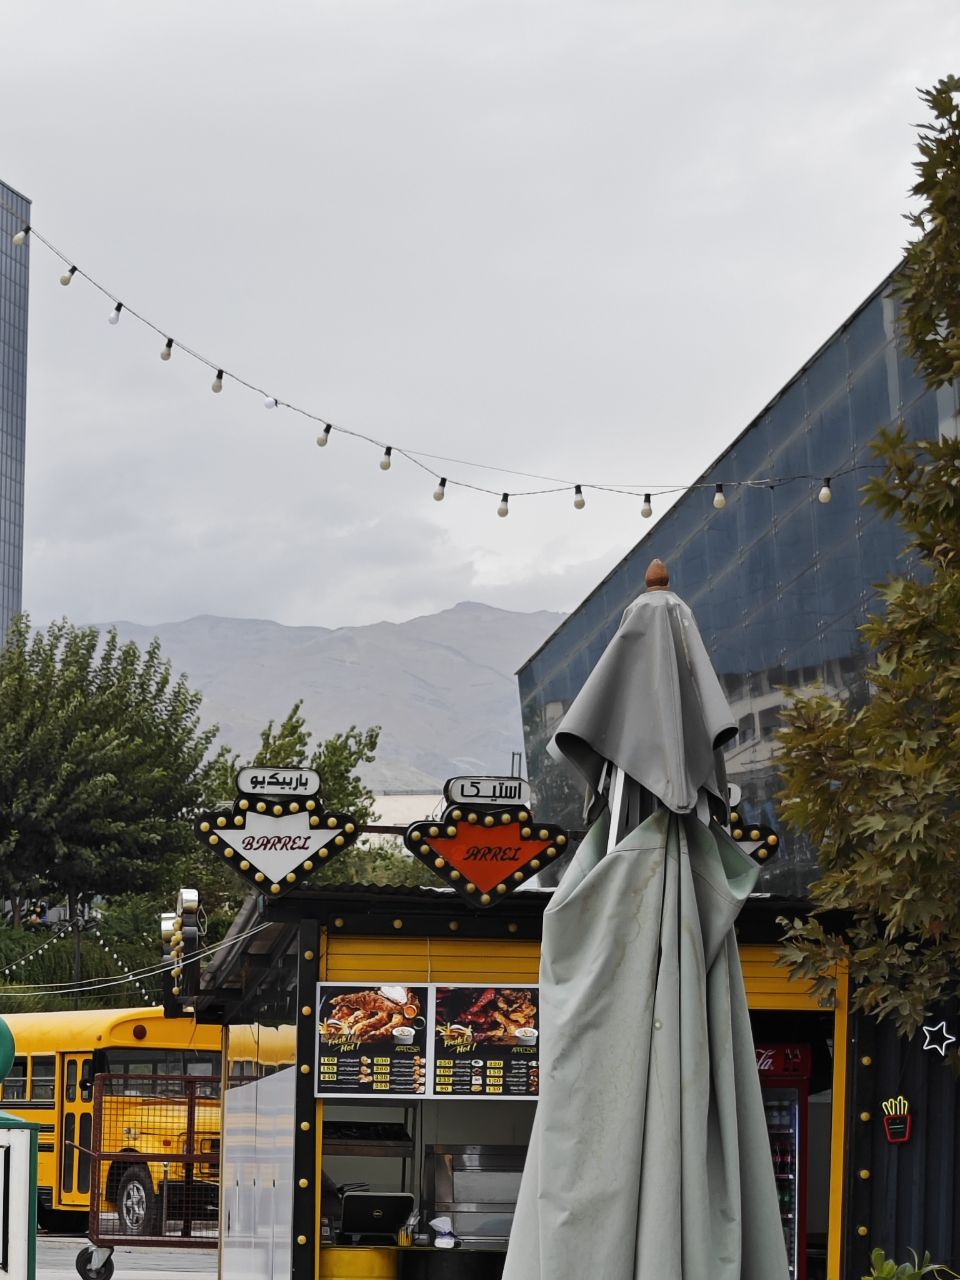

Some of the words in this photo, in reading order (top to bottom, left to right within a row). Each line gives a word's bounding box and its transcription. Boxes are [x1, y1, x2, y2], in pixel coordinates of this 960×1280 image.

[250, 773, 309, 791] باربیکیو
[460, 782, 522, 802] استیک
[242, 836, 311, 850] BARREL
